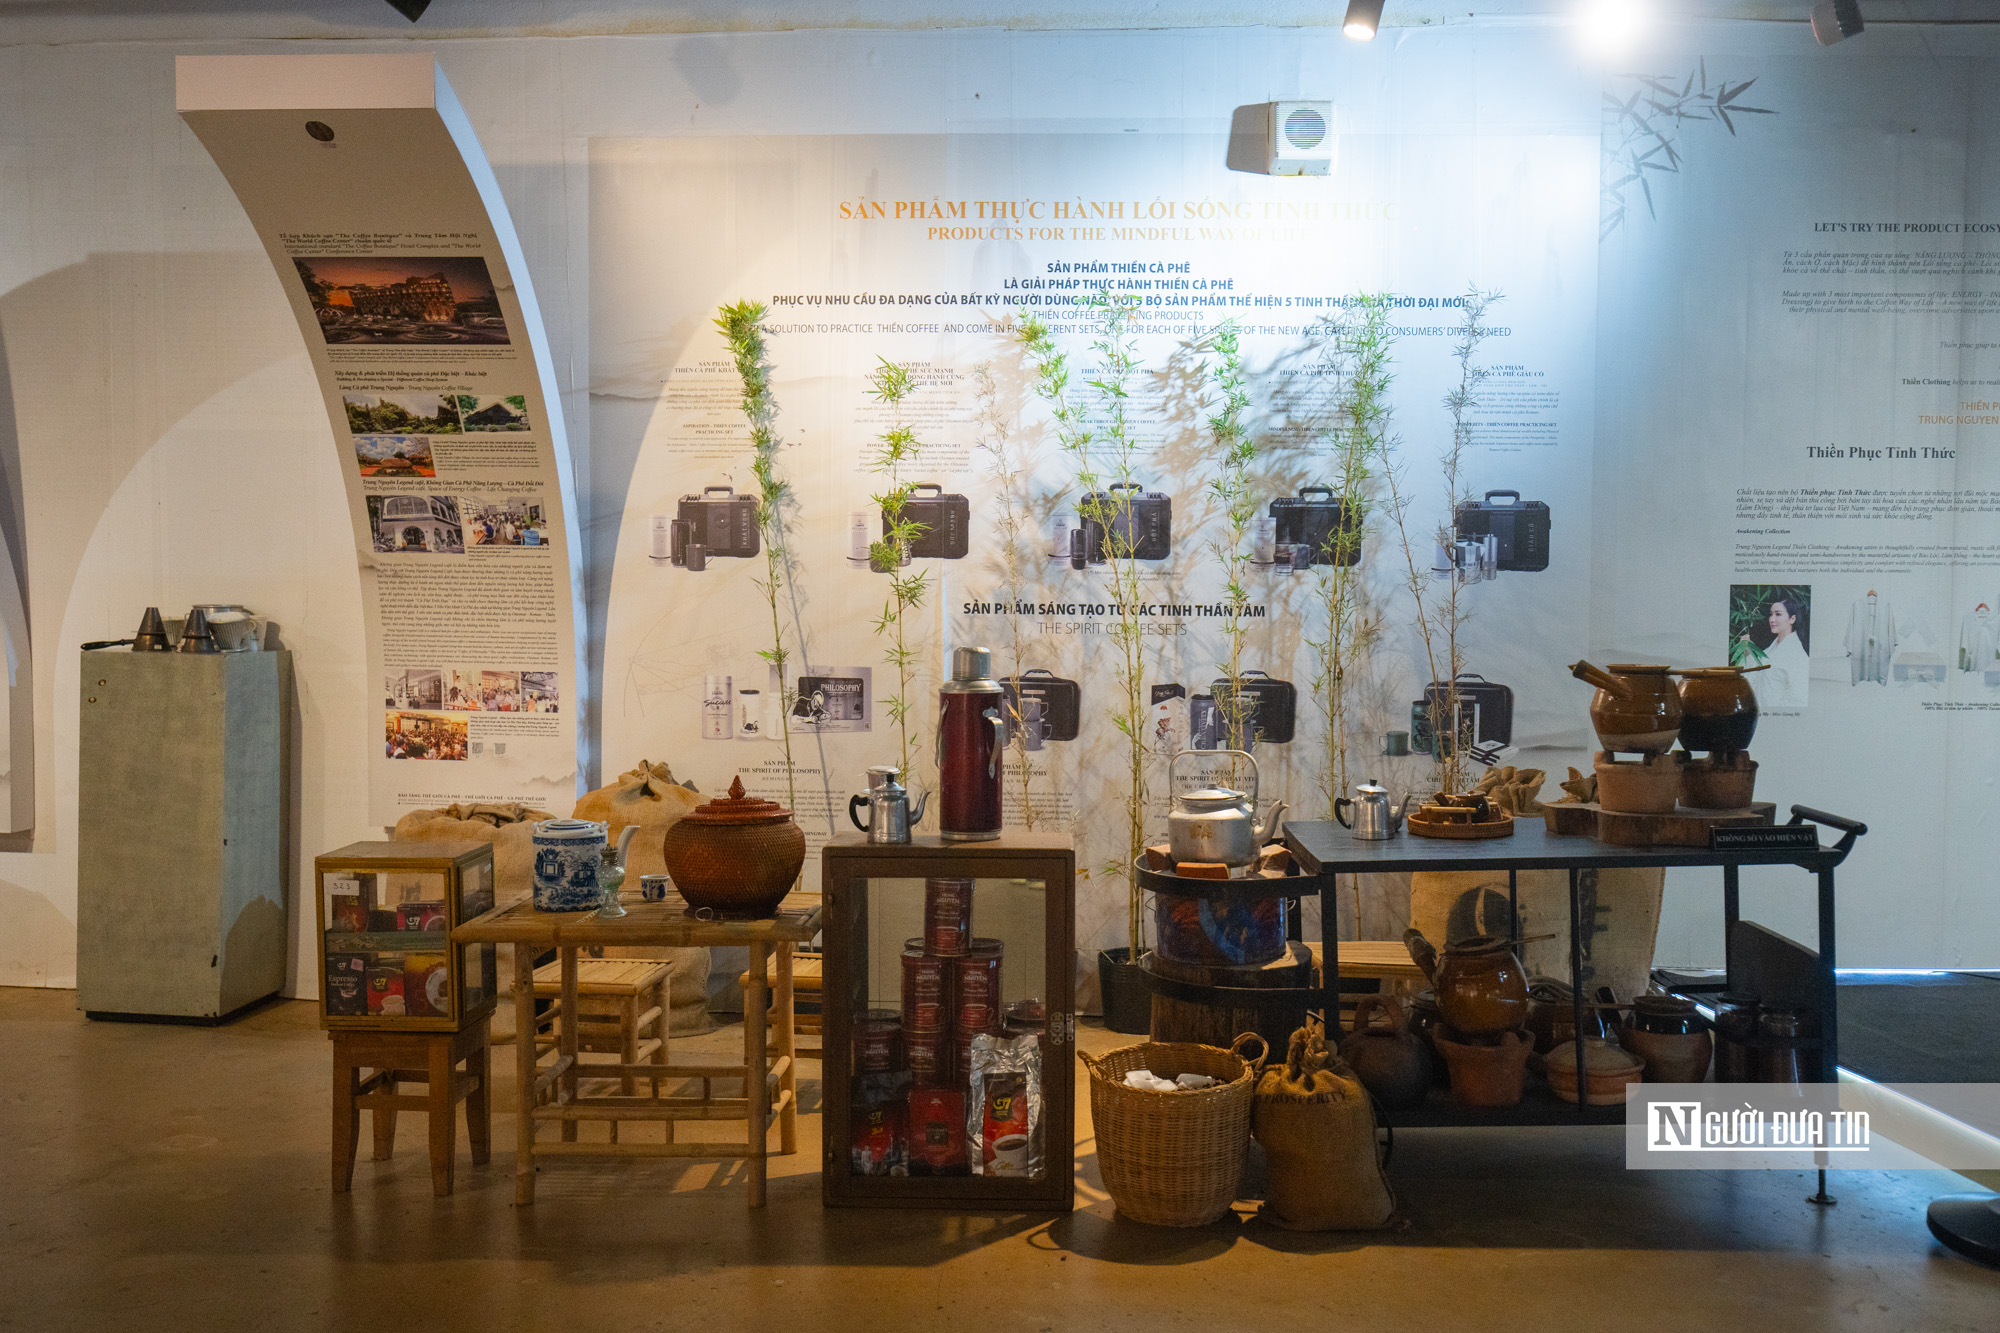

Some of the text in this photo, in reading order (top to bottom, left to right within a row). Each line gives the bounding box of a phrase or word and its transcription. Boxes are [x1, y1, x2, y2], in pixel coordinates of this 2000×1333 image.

[840, 196, 887, 220] SẢN
[894, 196, 967, 220] PHẨM
[974, 196, 1045, 224] THỰC
[1053, 196, 1126, 220] HÀNH
[1133, 196, 1175, 220] LỐI
[1814, 222, 1847, 233] LET'S
[1850, 222, 1874, 233] TRY
[1876, 222, 1900, 233] THE
[1904, 222, 1961, 233] PRODUCT
[928, 227, 1024, 241] PRODUCTS
[1029, 227, 1064, 241] FOR
[1070, 227, 1106, 241] THE
[1112, 227, 1195, 241] MINDFUL
[1047, 260, 1190, 273] SẢN PHẨM THIỀN CÀ PHÊ
[1004, 277, 1234, 290] LÀ GIẢI PHÁP THỰC HÀNH THIỀN CÀ PHÊ
[773, 295, 804, 308] PHỤC
[806, 295, 821, 308] VỤ
[826, 295, 850, 305] NHU
[853, 292, 876, 305] CẦU
[879, 295, 895, 305] ĐA
[898, 295, 932, 308] DẠNG
[934, 292, 958, 305] CỦA
[960, 292, 981, 305] BẤT
[985, 292, 1001, 305] KỲ
[1003, 292, 1042, 305] NGƯỜI
[1045, 293, 1078, 306] DÙNG
[1135, 296, 1143, 306] 5
[1146, 294, 1162, 309] BỘ
[1165, 294, 1189, 306] SẢN
[1191, 294, 1227, 306] PHẨM
[1229, 293, 1251, 306] THỂ
[1254, 294, 1282, 309] HIỆN
[1285, 297, 1292, 307] 5
[1295, 297, 1322, 307] TINH
[1387, 296, 1415, 307] THỜI
[1418, 297, 1439, 310] ĐẠI
[1442, 296, 1465, 308] MỚI
[770, 324, 814, 334] SOLUTION
[816, 324, 828, 334] TO
[831, 324, 872, 334] PRACTICE
[906, 324, 939, 334] COFFEE
[944, 324, 964, 334] AND
[966, 324, 992, 334] COME
[995, 324, 1005, 334] IN
[1127, 325, 1144, 334] FOR
[1147, 325, 1170, 334] EACH
[1173, 325, 1185, 334] OF
[1188, 325, 1206, 334] FIVE
[1244, 326, 1257, 335] OF
[1258, 326, 1276, 335] THE
[1278, 326, 1299, 335] NEW
[1302, 326, 1323, 336] AGE,
[1487, 327, 1511, 336] NEED
[1902, 378, 1920, 387] Thiền
[1922, 378, 1951, 387] Clothing
[1960, 400, 1990, 411] THIỀN
[1919, 415, 1999, 424] TRUNG NGUYEN
[1807, 443, 1844, 458] Thiền
[1849, 446, 1881, 461] Phục
[1921, 446, 1956, 458] Thức
[964, 599, 990, 615] SẢN
[1038, 601, 1075, 615] SÁNG
[1079, 604, 1105, 619] TẠO
[1159, 605, 1191, 616] TINH
[1195, 602, 1232, 617] THẦN
[1038, 622, 1061, 634] THE
[1066, 622, 1100, 634] SPIRIT
[1158, 622, 1187, 635] SETS
[821, 684, 861, 692] PHILOSOPHY
[407, 916, 420, 926] G7
[328, 975, 357, 984] Espresso
[373, 978, 387, 986] G7
[993, 1097, 1011, 1110] G7
